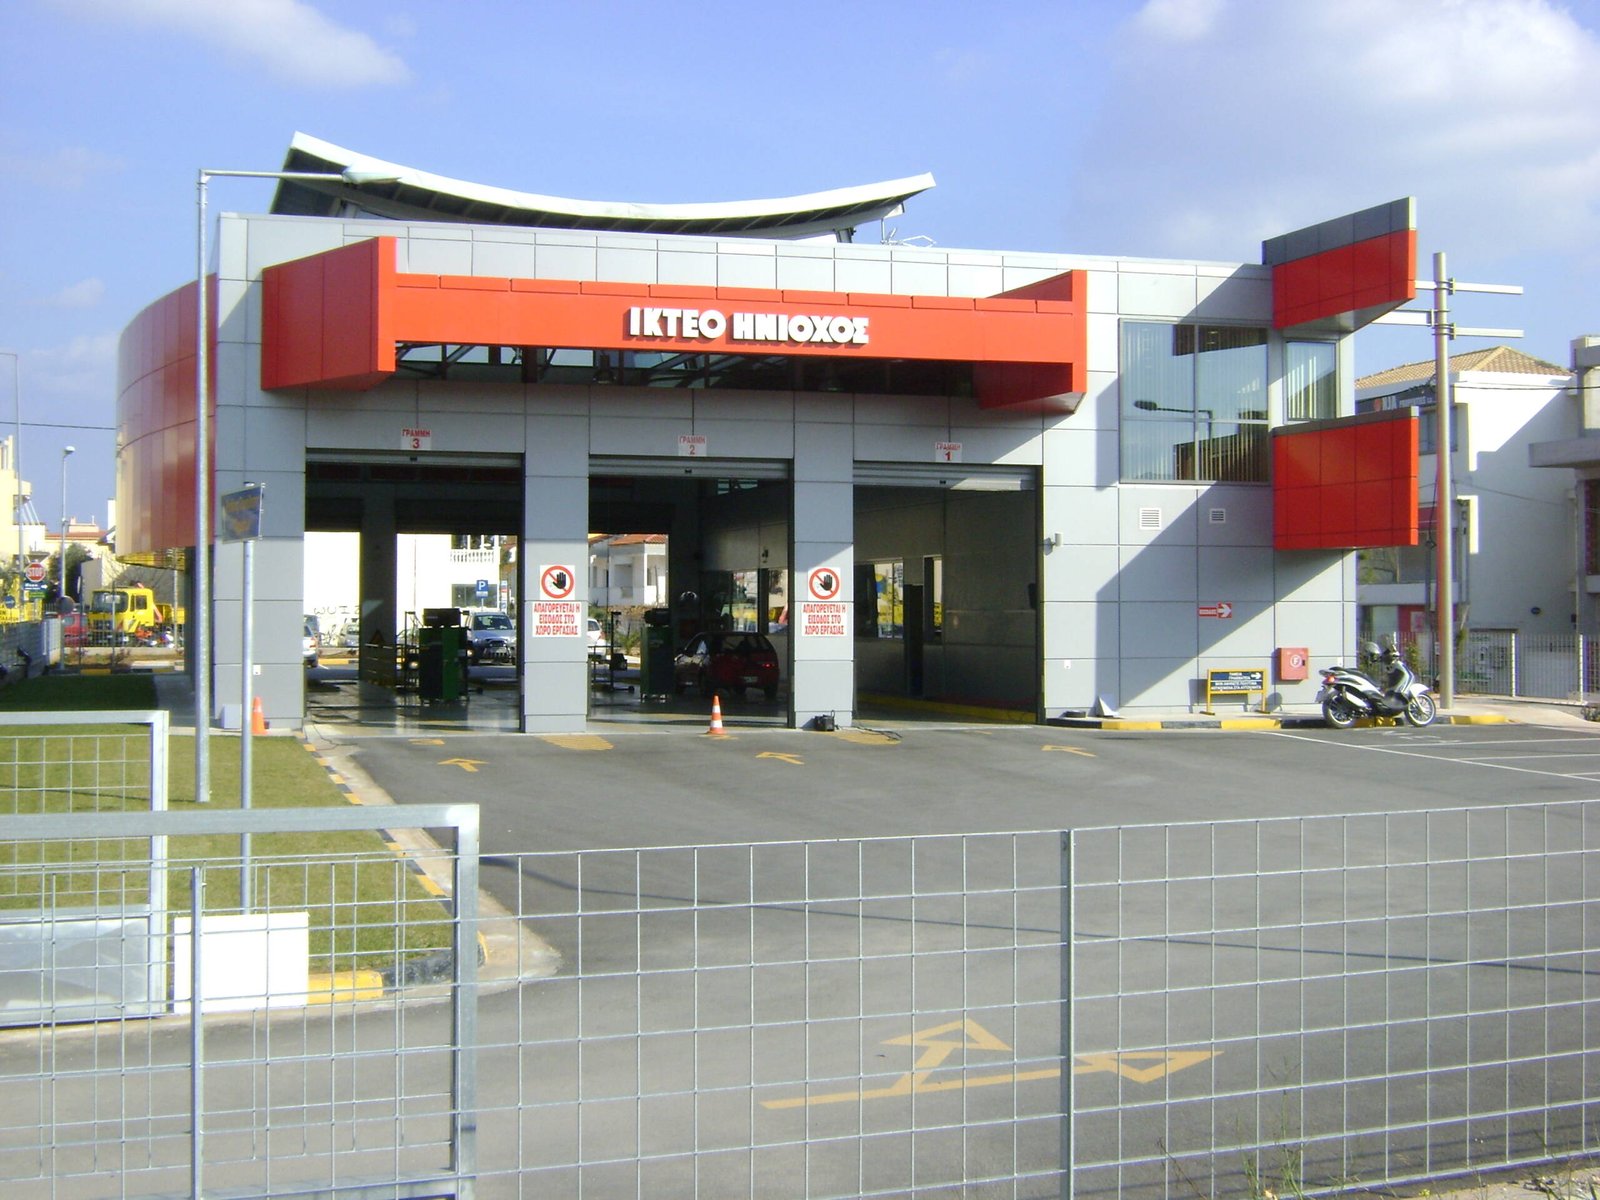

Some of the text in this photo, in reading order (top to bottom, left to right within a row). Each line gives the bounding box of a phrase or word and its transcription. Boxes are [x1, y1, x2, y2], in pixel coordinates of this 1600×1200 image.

[628, 306, 870, 344] ΙΚΤΕΟ ΗΝΙΟΧΟΣ
[412, 438, 420, 449] 3
[688, 444, 696, 455] 2
[944, 451, 951, 461] 1
[27, 567, 45, 577] STOP
[478, 581, 486, 591] P
[564, 614, 575, 624] ΣΤΟ
